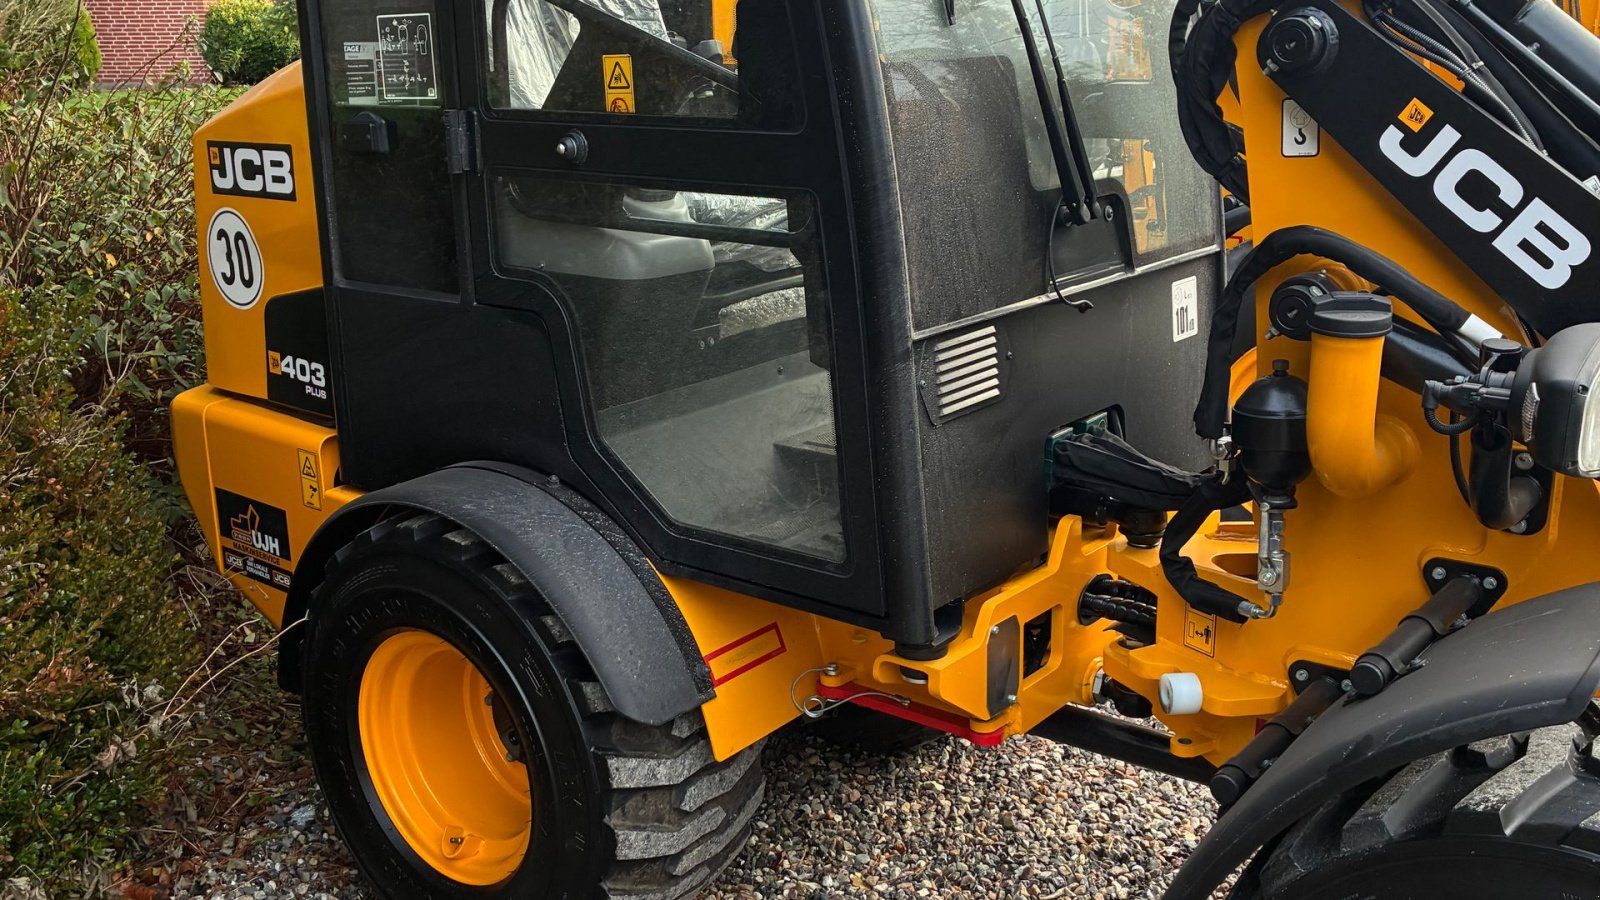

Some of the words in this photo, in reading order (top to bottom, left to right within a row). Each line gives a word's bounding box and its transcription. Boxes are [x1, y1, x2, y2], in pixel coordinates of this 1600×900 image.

[212, 147, 294, 194] JCB
[1379, 123, 1591, 289] JCB
[217, 228, 254, 288] 30
[1176, 305, 1188, 335] 101
[281, 355, 326, 387] 403
[305, 385, 327, 399] PLUS
[251, 529, 280, 556] UJH
[227, 555, 242, 567] JCB
[274, 574, 291, 586] JCB
